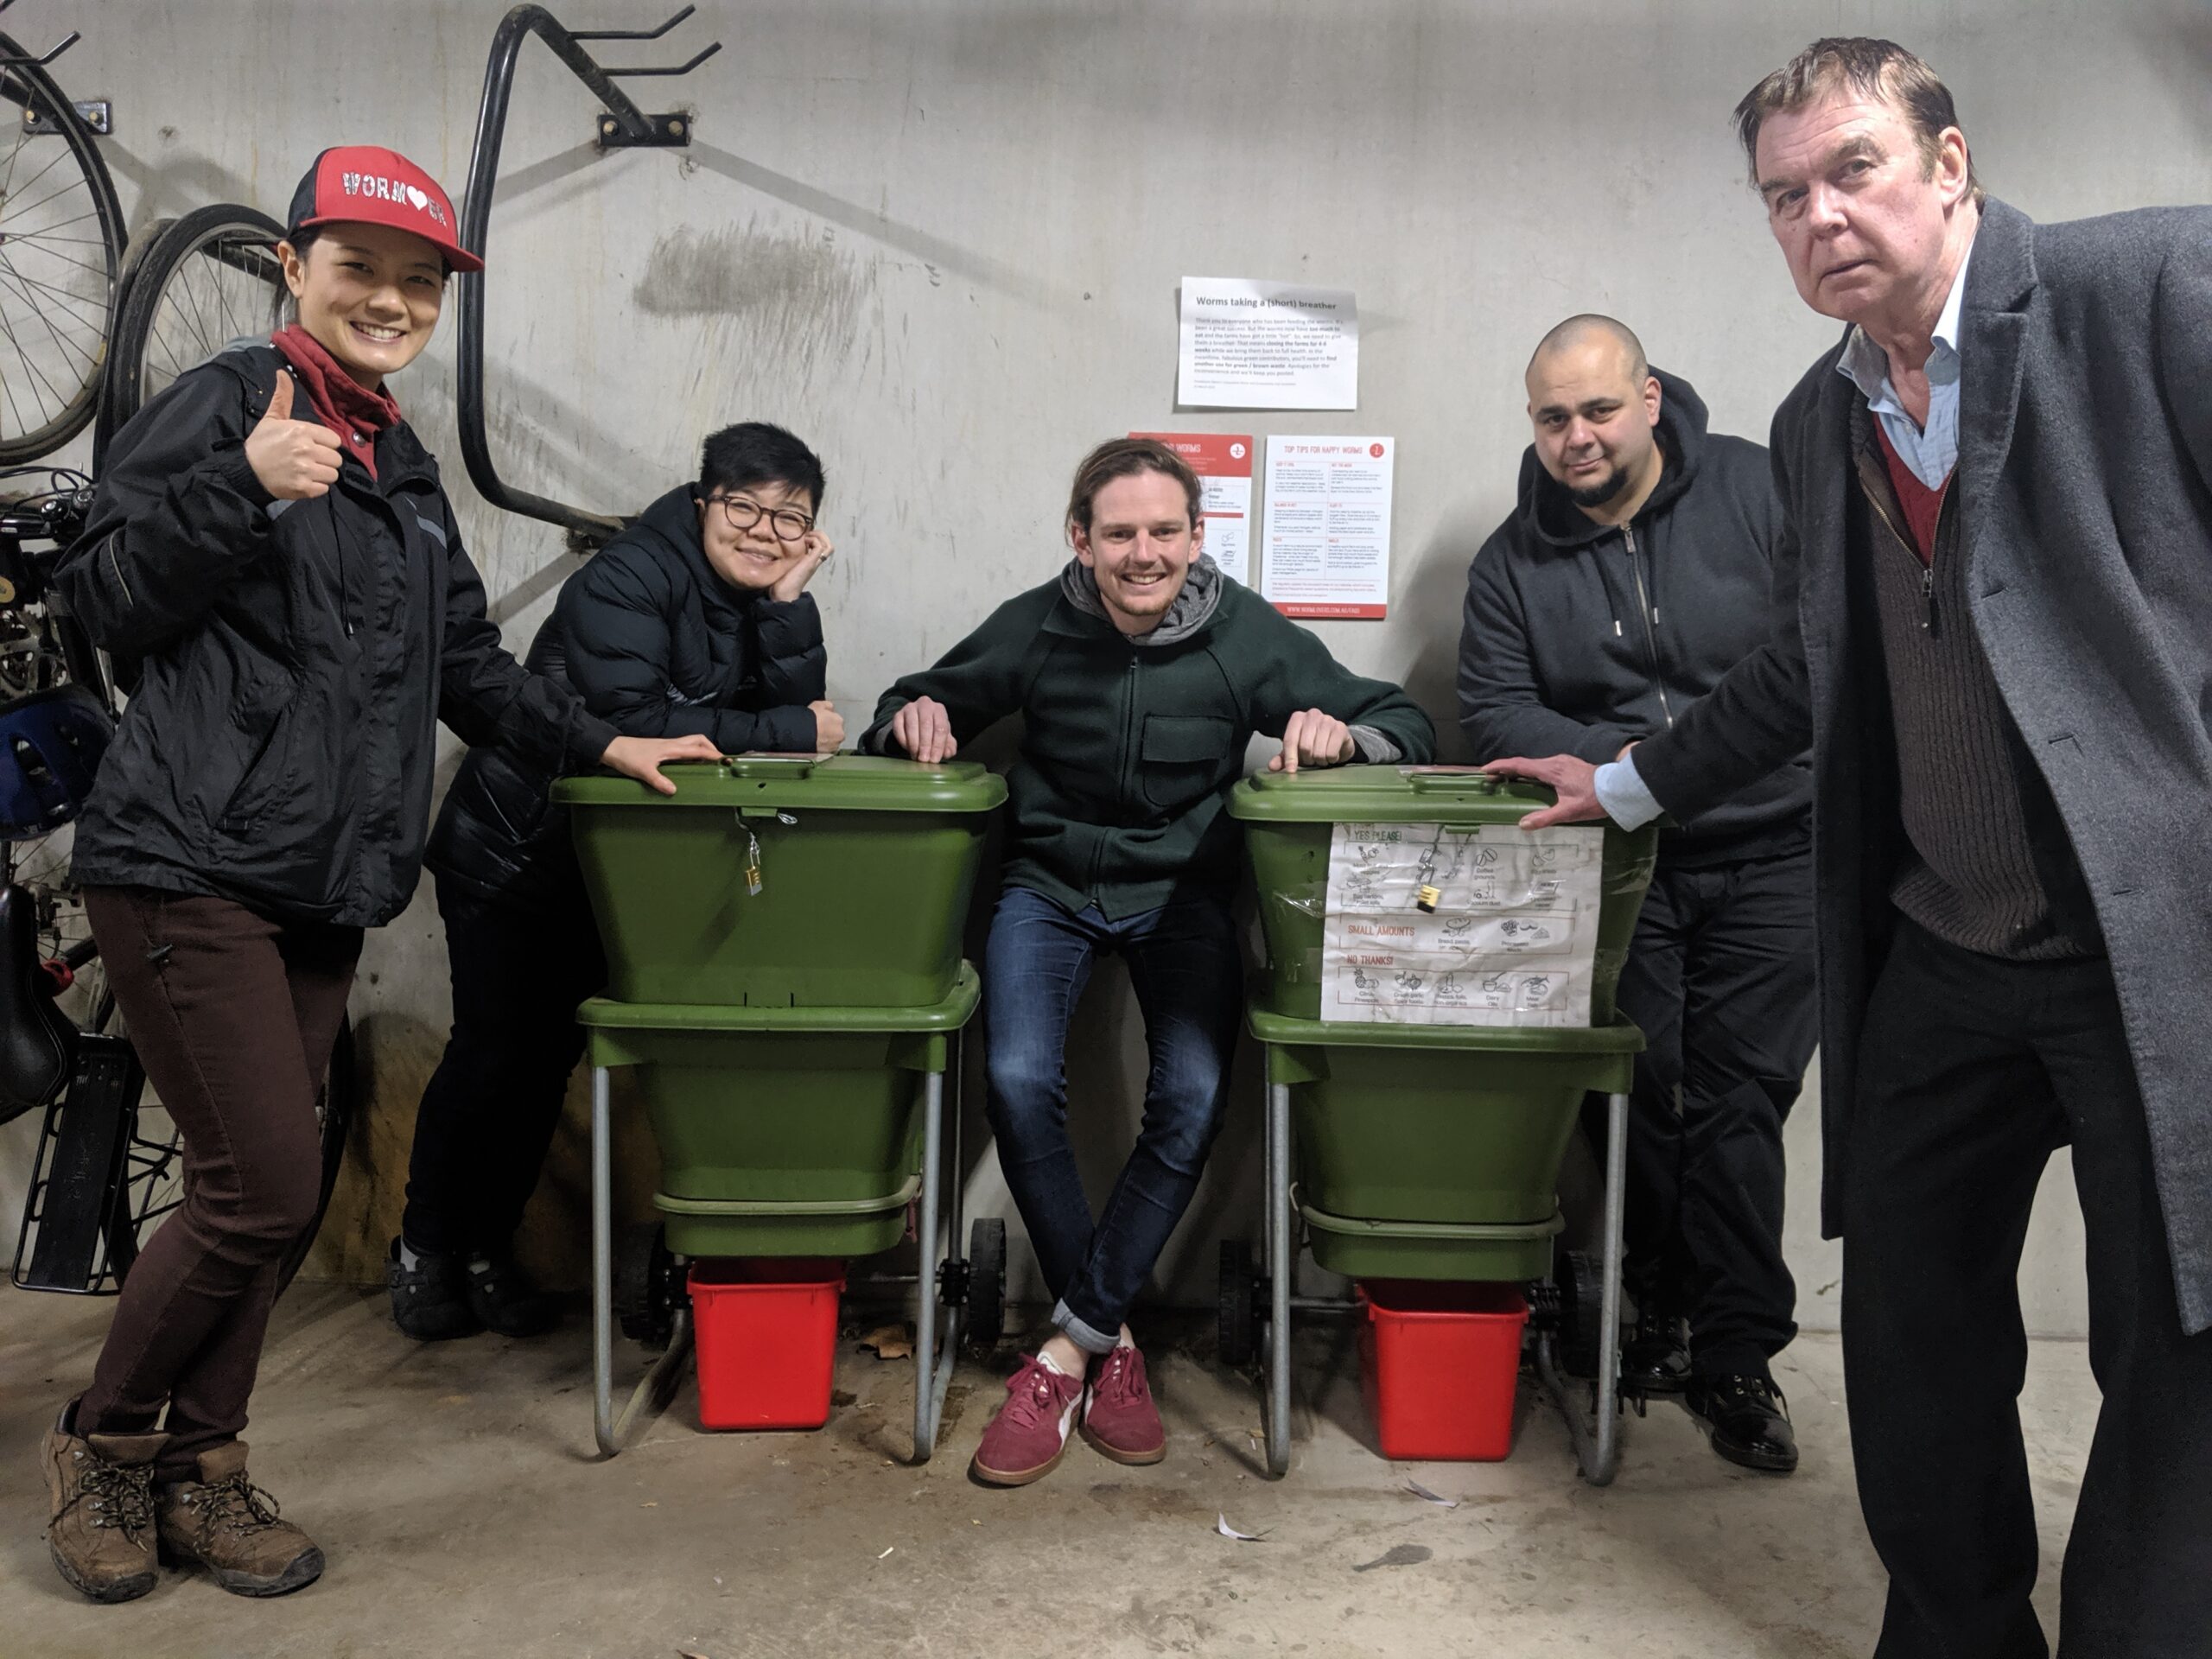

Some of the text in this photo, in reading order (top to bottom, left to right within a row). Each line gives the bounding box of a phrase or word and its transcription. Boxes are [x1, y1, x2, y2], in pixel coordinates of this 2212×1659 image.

[1196, 296, 1229, 306] Worms
[1230, 297, 1258, 308] taking
[1268, 298, 1297, 308] (short)
[1299, 300, 1337, 309] breather
[1176, 443, 1202, 453] WORMS
[1354, 830, 1370, 841] YES
[1348, 925, 1414, 936] SMALL AMOUNTS
[1347, 954, 1394, 965] NO THANKS!
